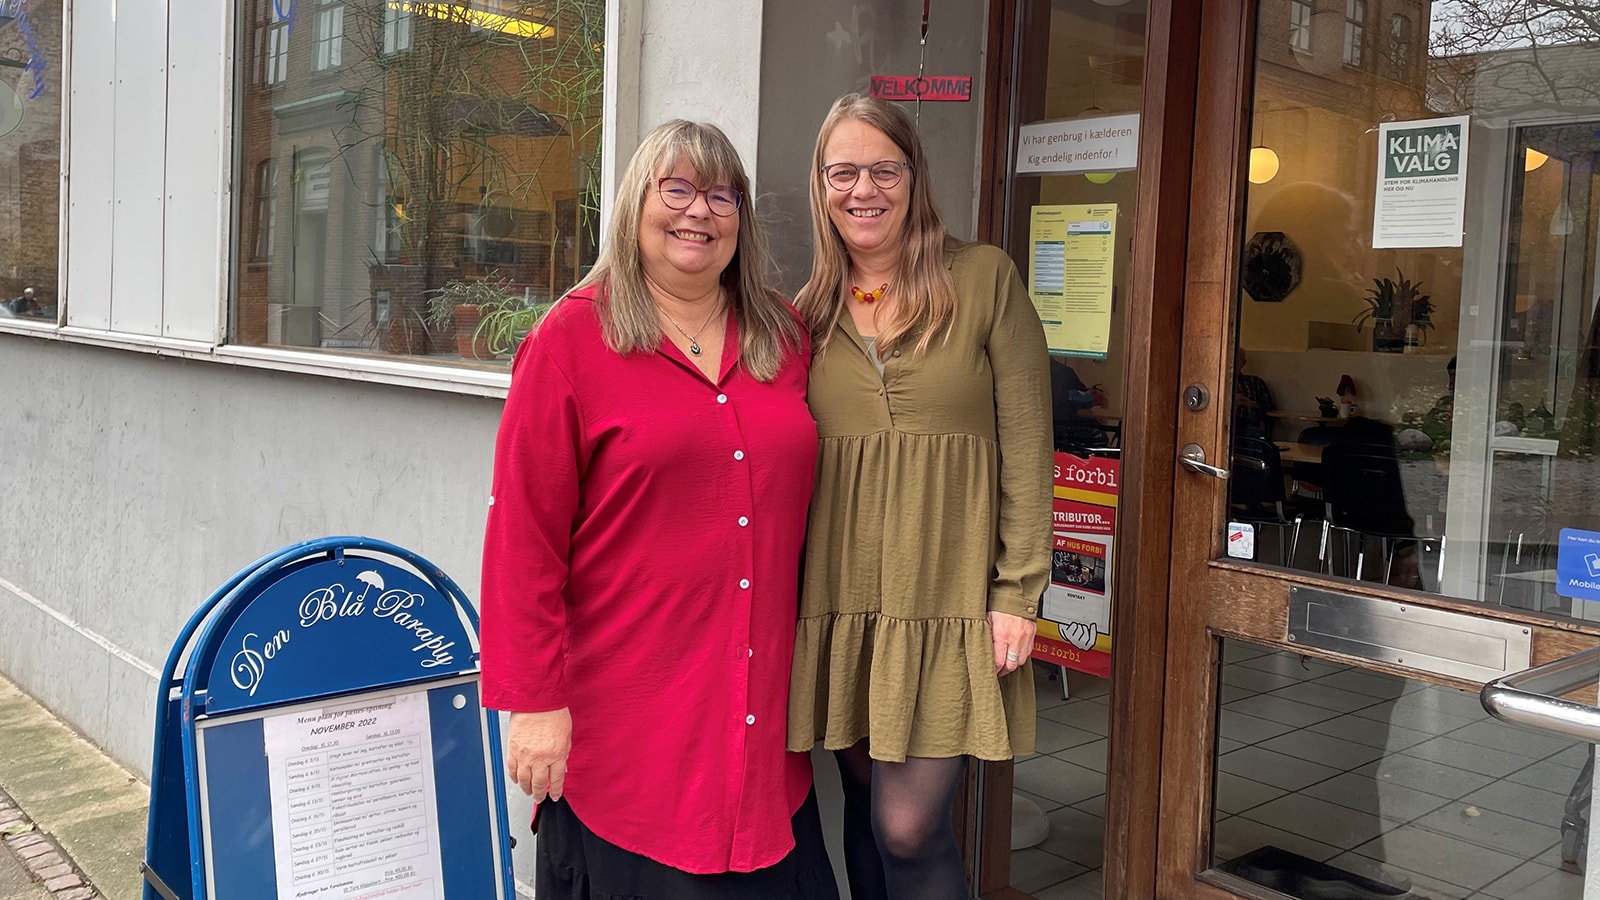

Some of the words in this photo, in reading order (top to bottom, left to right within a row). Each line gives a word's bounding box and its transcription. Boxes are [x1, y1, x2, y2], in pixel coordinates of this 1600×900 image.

[871, 80, 970, 96] VELKOMME
[1023, 136, 1031, 145] Vi
[1033, 135, 1046, 145] har
[1047, 132, 1083, 145] genbrug
[1090, 128, 1132, 139] kælderen
[1390, 133, 1458, 154] KLIMA
[1028, 155, 1040, 166] Kig
[1042, 153, 1073, 164] endelig
[1075, 148, 1112, 161] indenfor
[1393, 153, 1451, 173] VALG
[1066, 464, 1117, 487] forbi
[1067, 541, 1080, 550] HUS
[1082, 544, 1102, 554] FORBI
[230, 629, 290, 697] Den
[298, 583, 366, 628] Blå
[373, 589, 456, 668] Paraply
[1050, 646, 1081, 662] forbi
[310, 722, 355, 735] NOVEMBER
[358, 718, 377, 727] 2022
